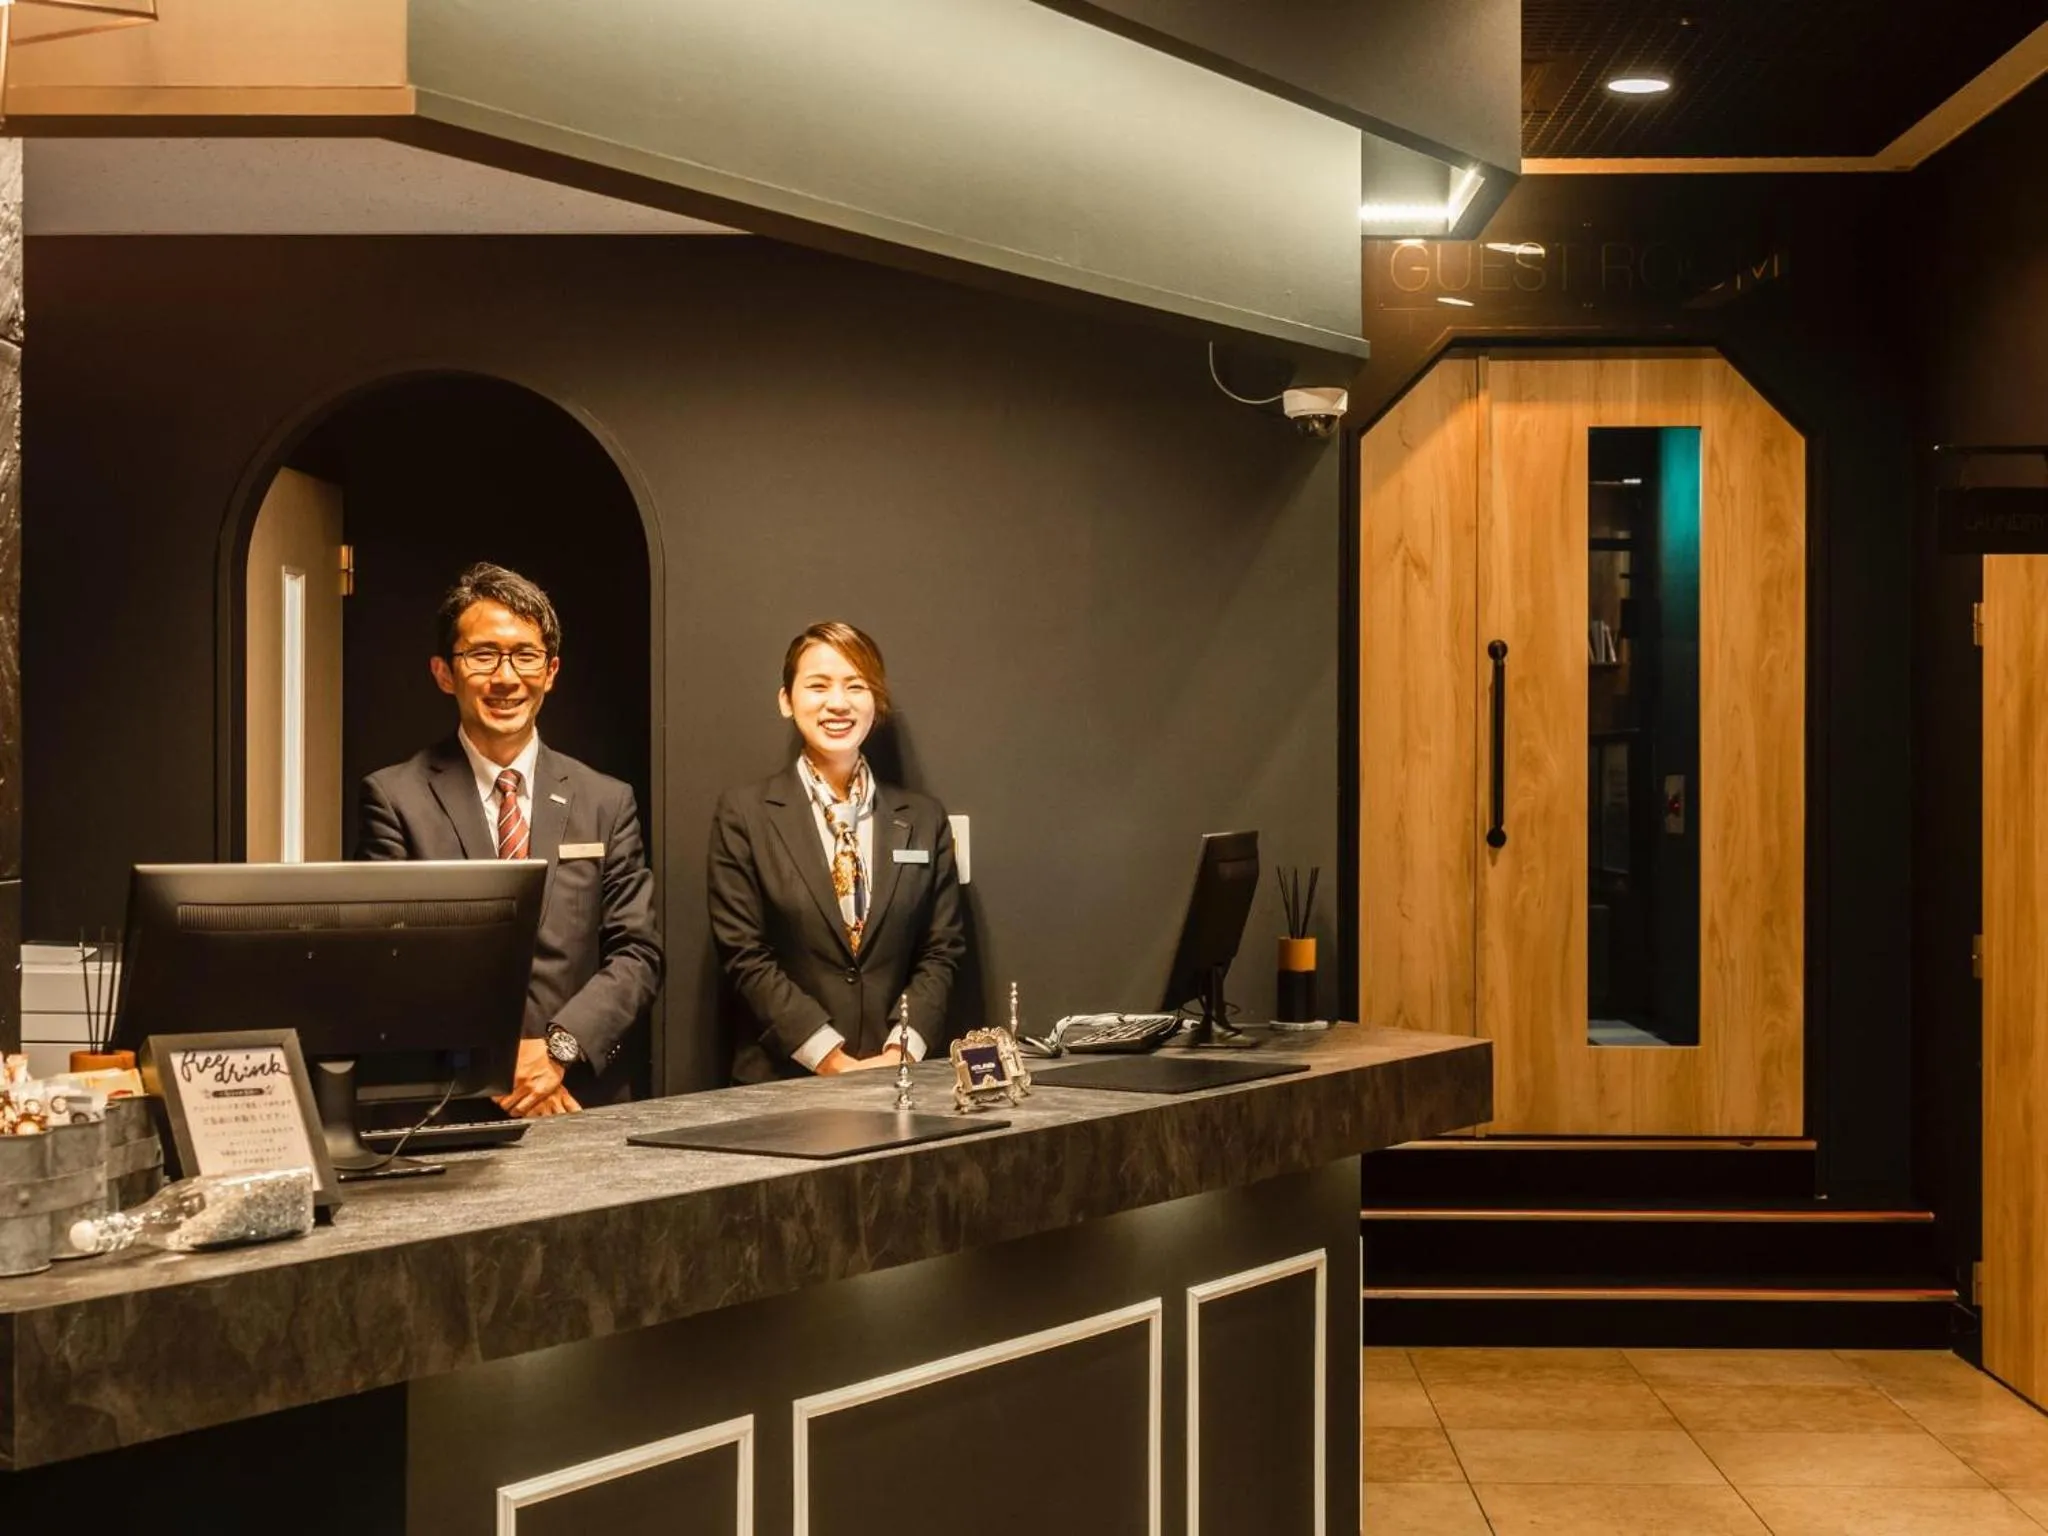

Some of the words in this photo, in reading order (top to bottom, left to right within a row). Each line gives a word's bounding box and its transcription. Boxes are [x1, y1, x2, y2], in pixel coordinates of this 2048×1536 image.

[1389, 240, 1577, 292] GUEST
[181, 1050, 224, 1083] free
[214, 1053, 293, 1084] drink
